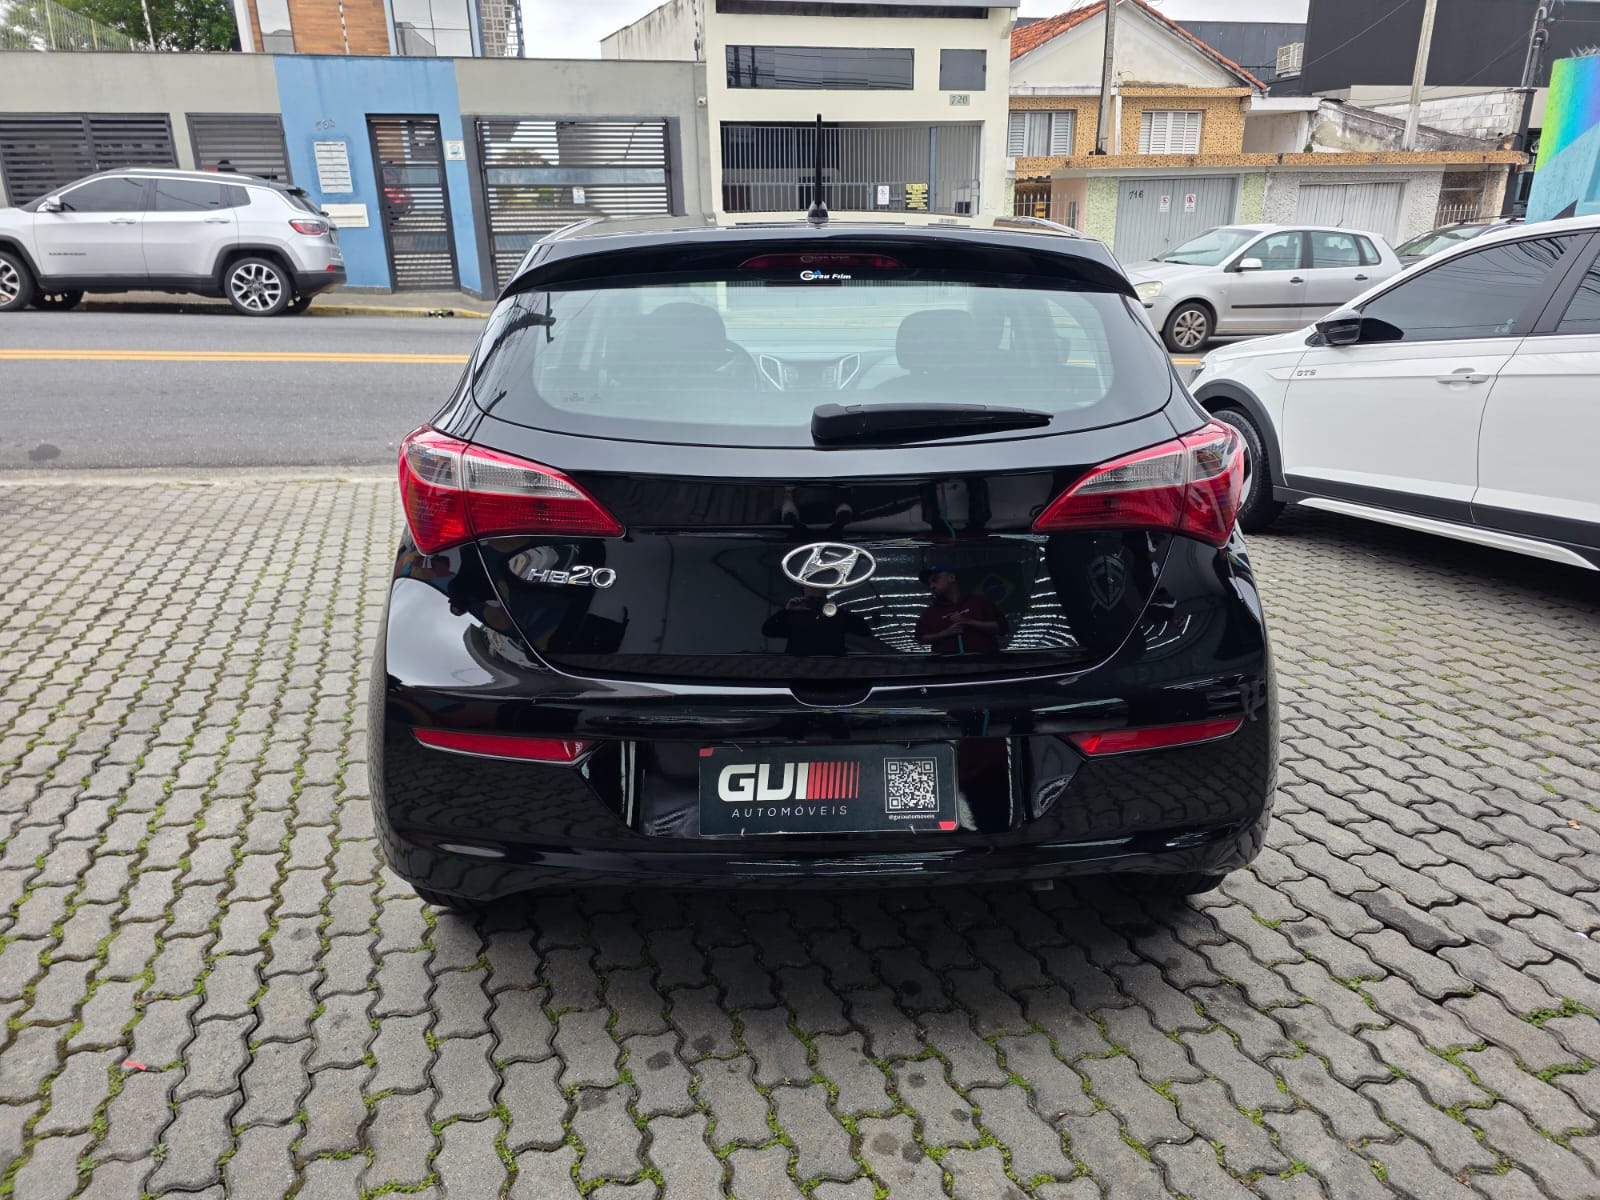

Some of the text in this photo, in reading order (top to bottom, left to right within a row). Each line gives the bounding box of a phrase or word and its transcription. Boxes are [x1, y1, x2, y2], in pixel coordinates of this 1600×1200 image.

[1129, 190, 1144, 200] 716
[1296, 369, 1317, 377] GTS
[526, 565, 616, 589] HB20
[717, 762, 809, 802] GUI
[731, 804, 848, 818] AUTOMÓVEIS
